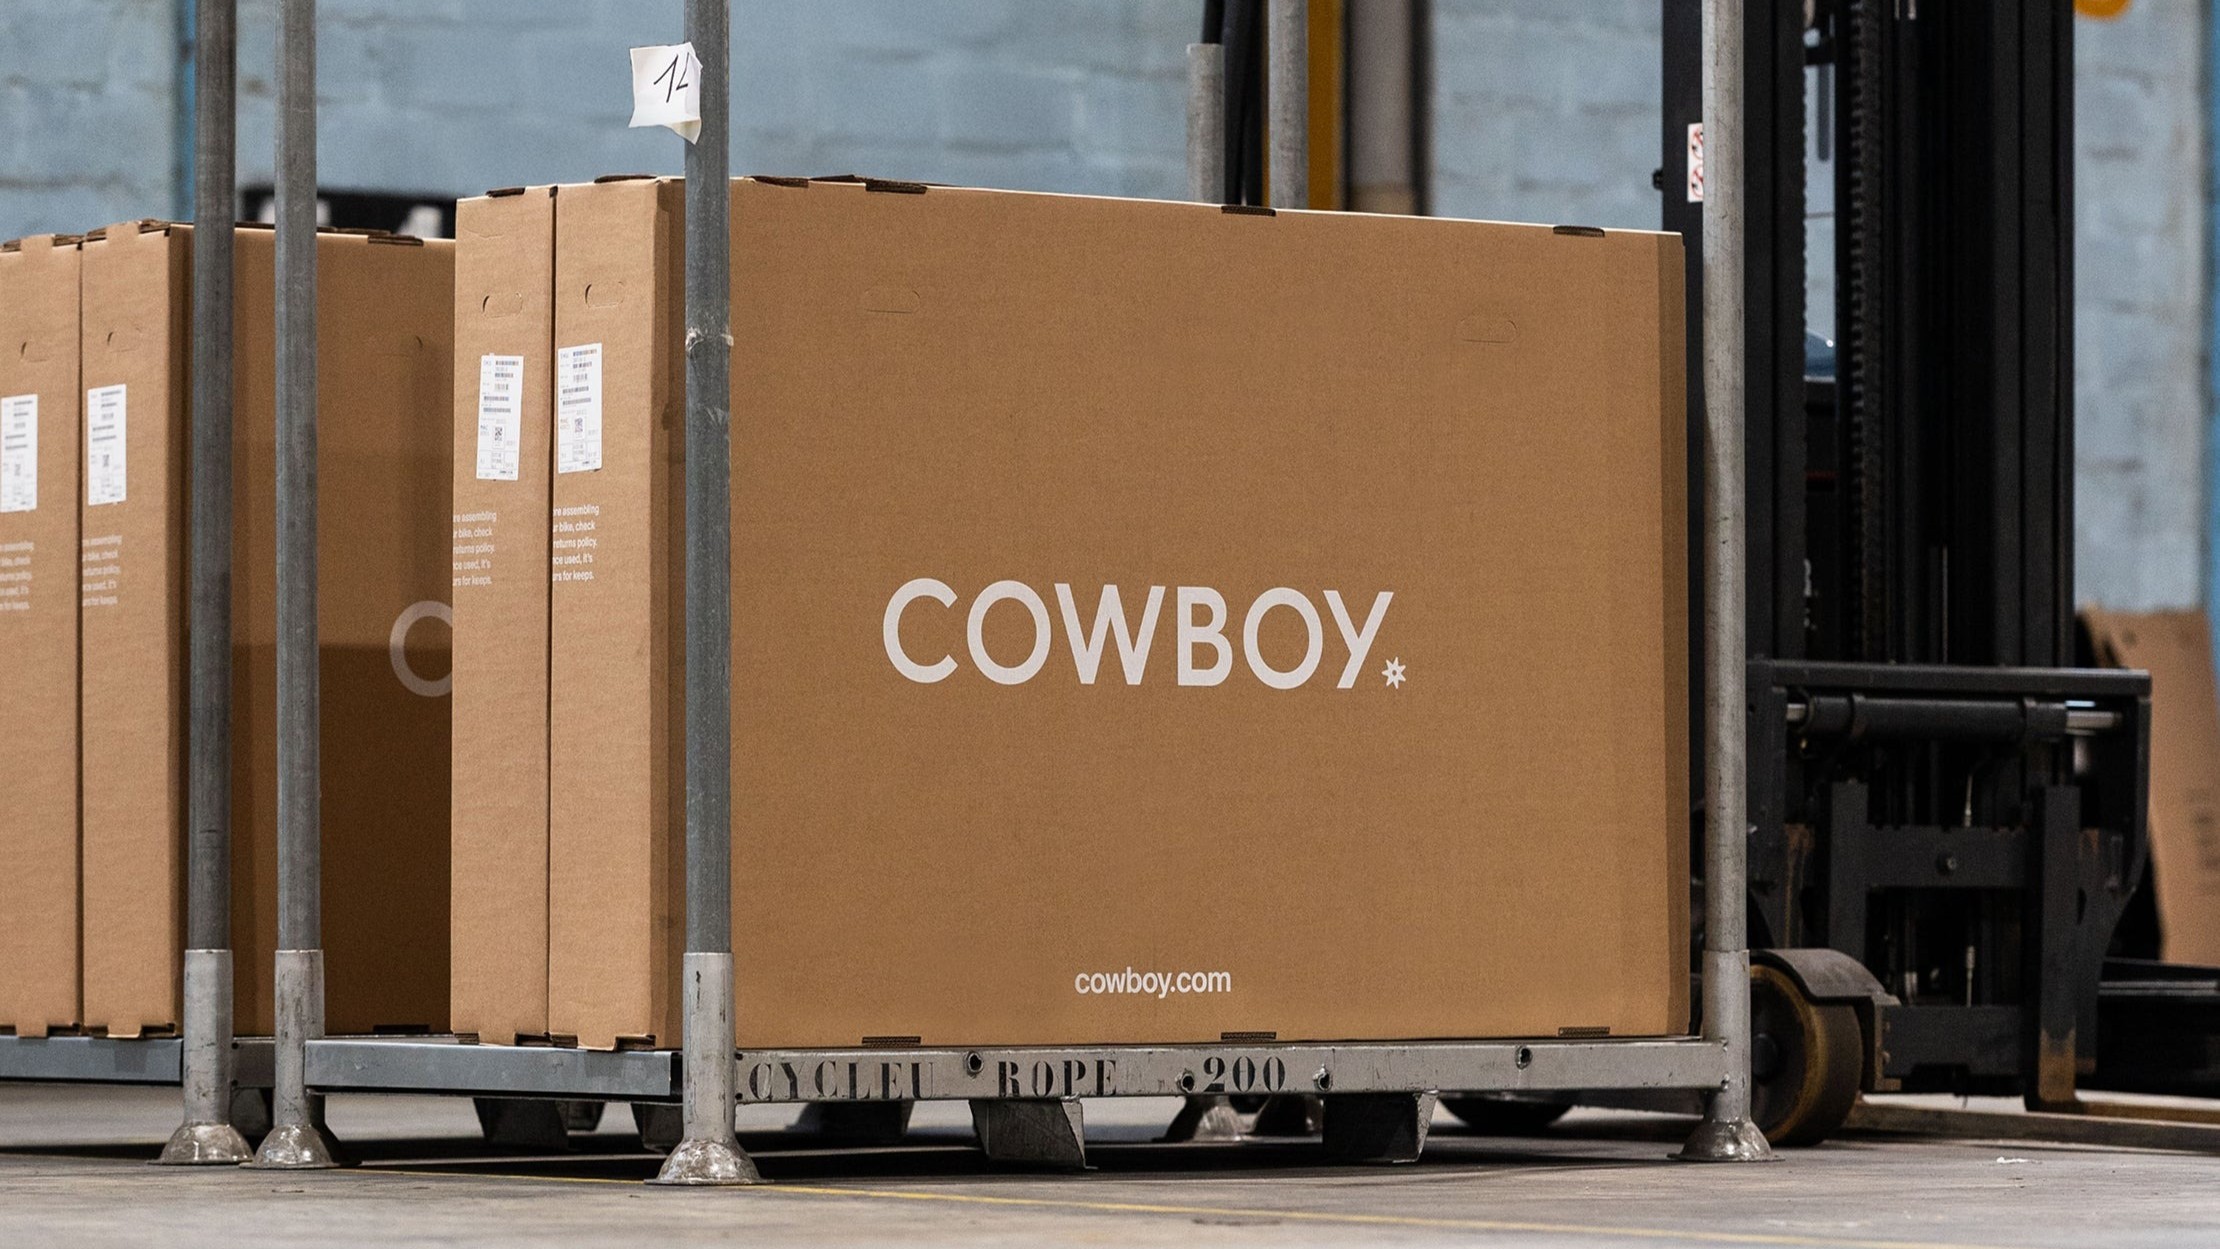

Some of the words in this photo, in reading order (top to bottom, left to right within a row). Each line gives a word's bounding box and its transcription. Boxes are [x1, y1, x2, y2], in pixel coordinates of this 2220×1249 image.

[562, 504, 599, 516] assembling
[575, 520, 595, 531] check
[563, 570, 572, 581] for
[1074, 966, 1231, 999] cowboy.com
[1203, 1056, 1286, 1094] 200
